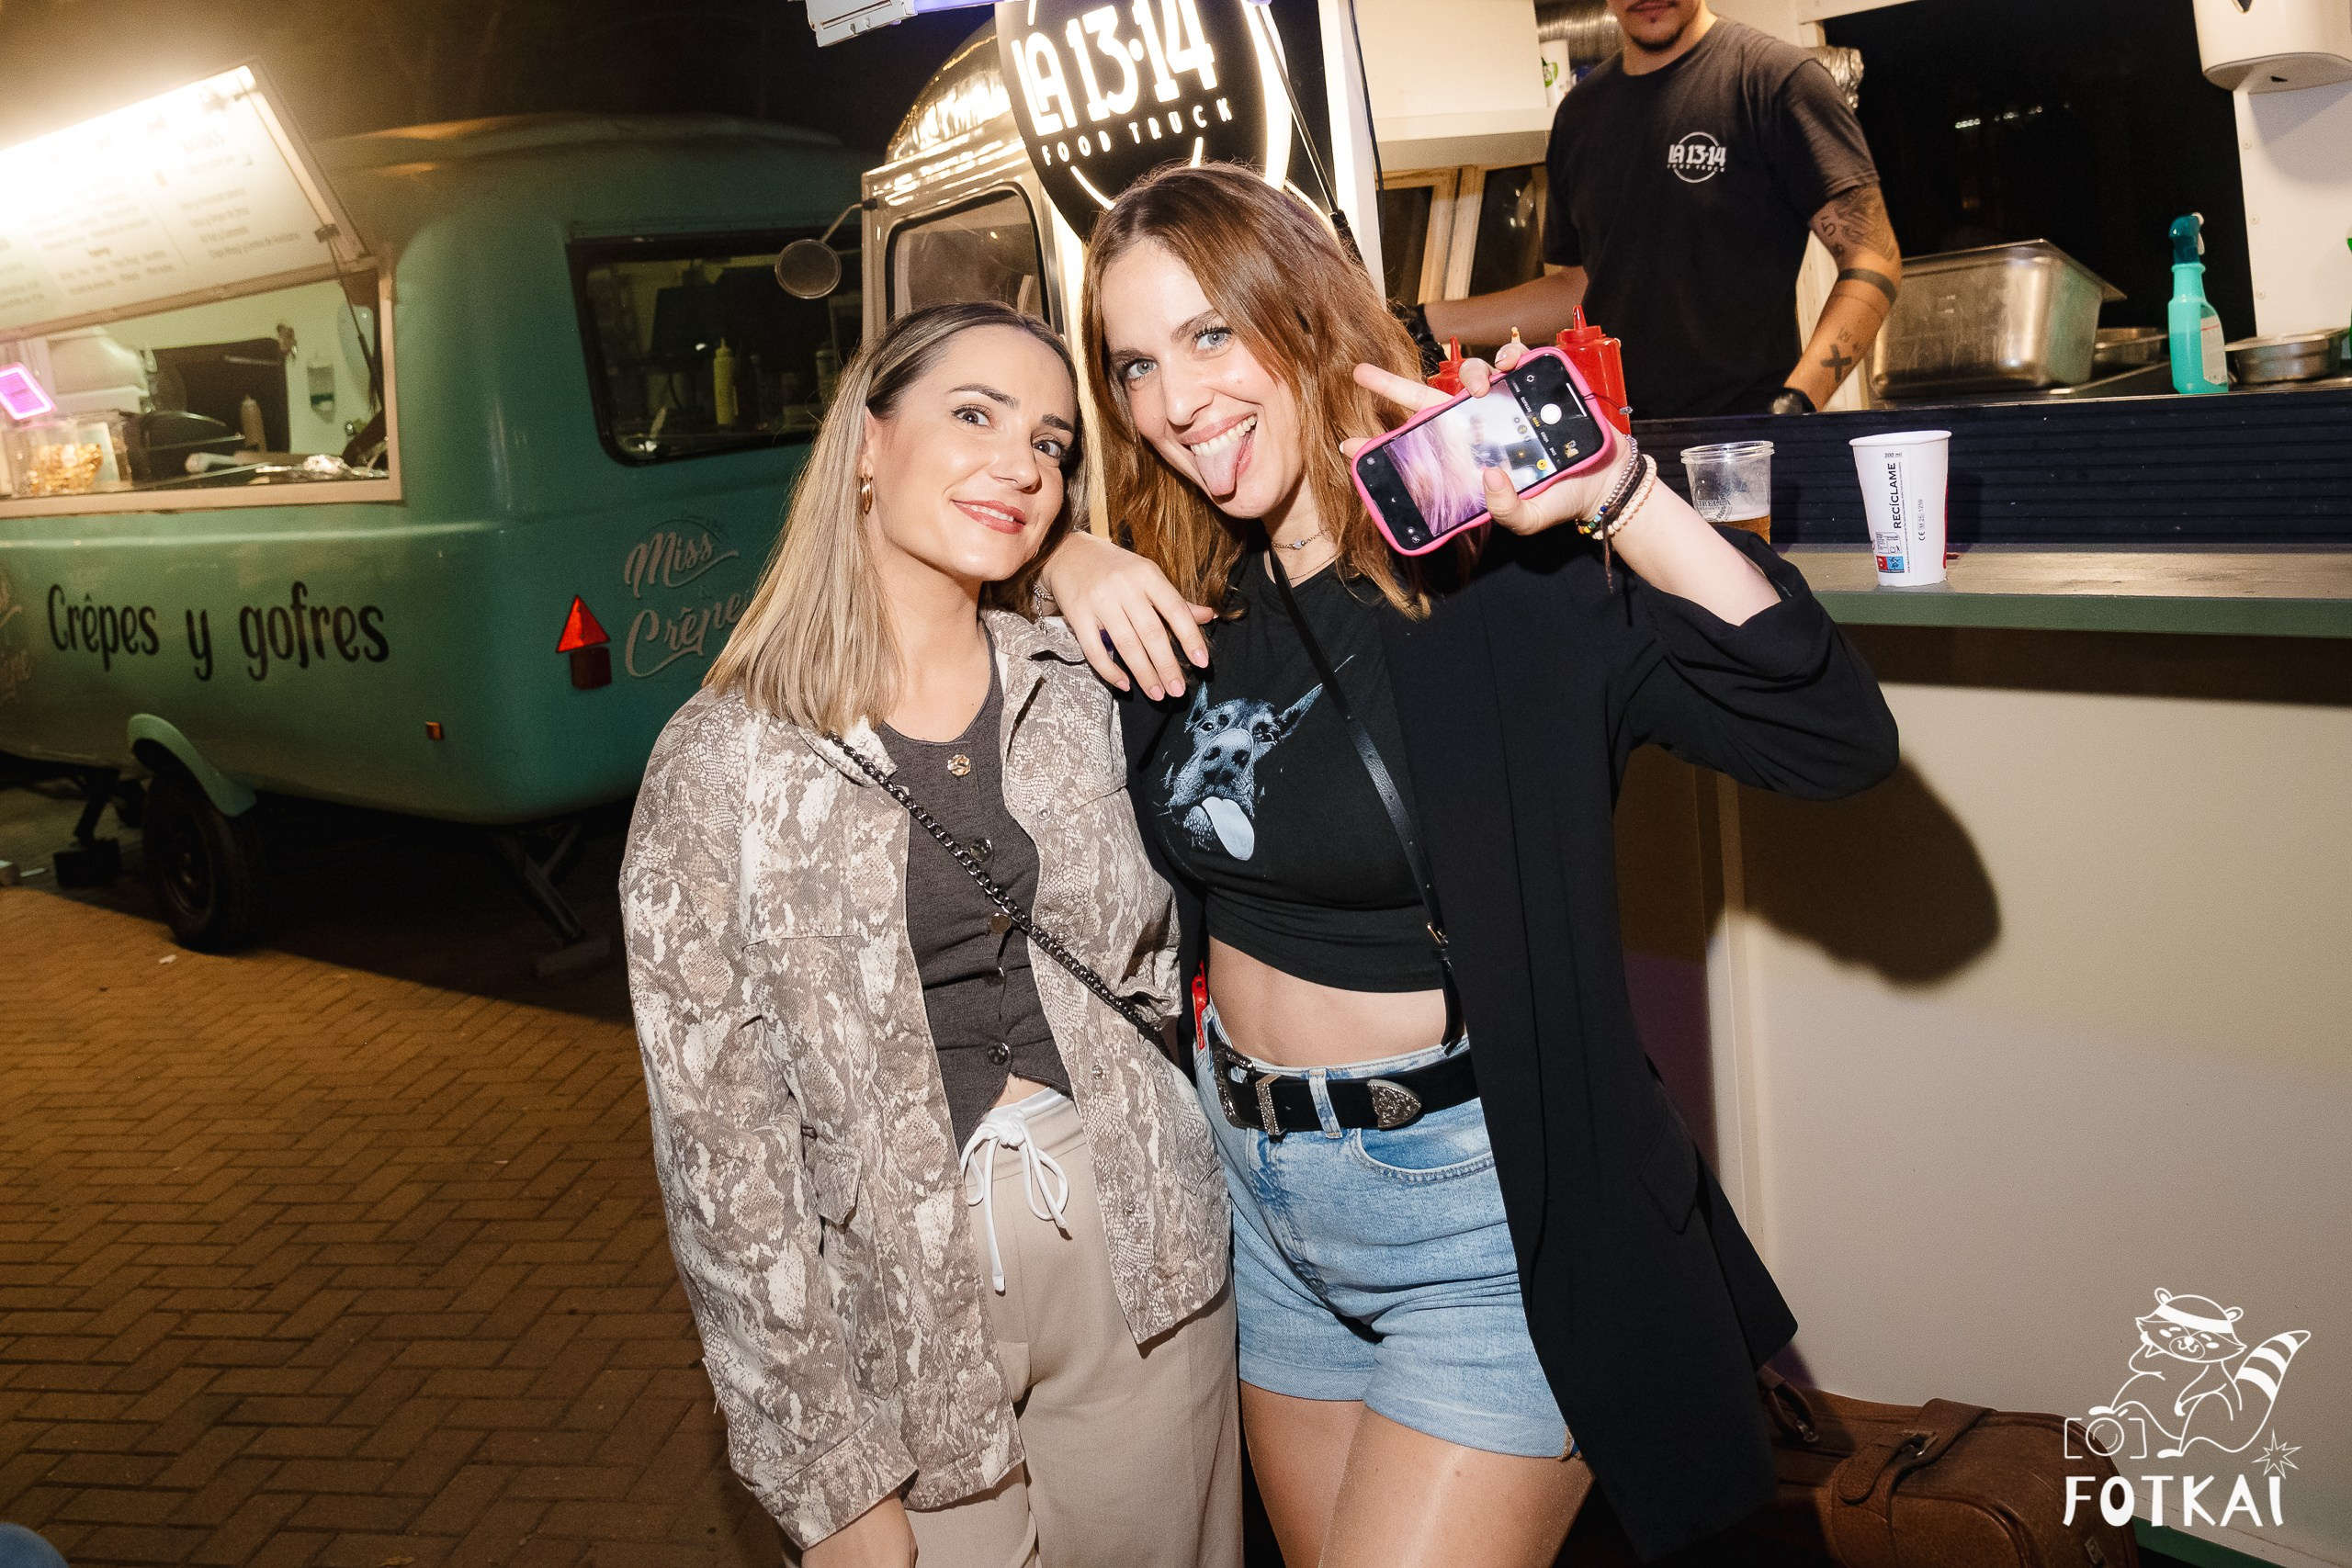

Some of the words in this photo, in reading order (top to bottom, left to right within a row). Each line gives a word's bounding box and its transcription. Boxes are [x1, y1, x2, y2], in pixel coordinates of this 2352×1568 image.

[1011, 31, 1079, 137] LA
[1041, 130, 1112, 166] FOOD
[1128, 97, 1233, 145] TRUCK
[1668, 144, 1685, 164] LA
[1887, 462, 1902, 529] RECÍCLAME
[624, 531, 739, 598] Miss
[48, 583, 161, 671] Crêpes
[186, 608, 213, 682] y
[239, 581, 390, 682] gofres
